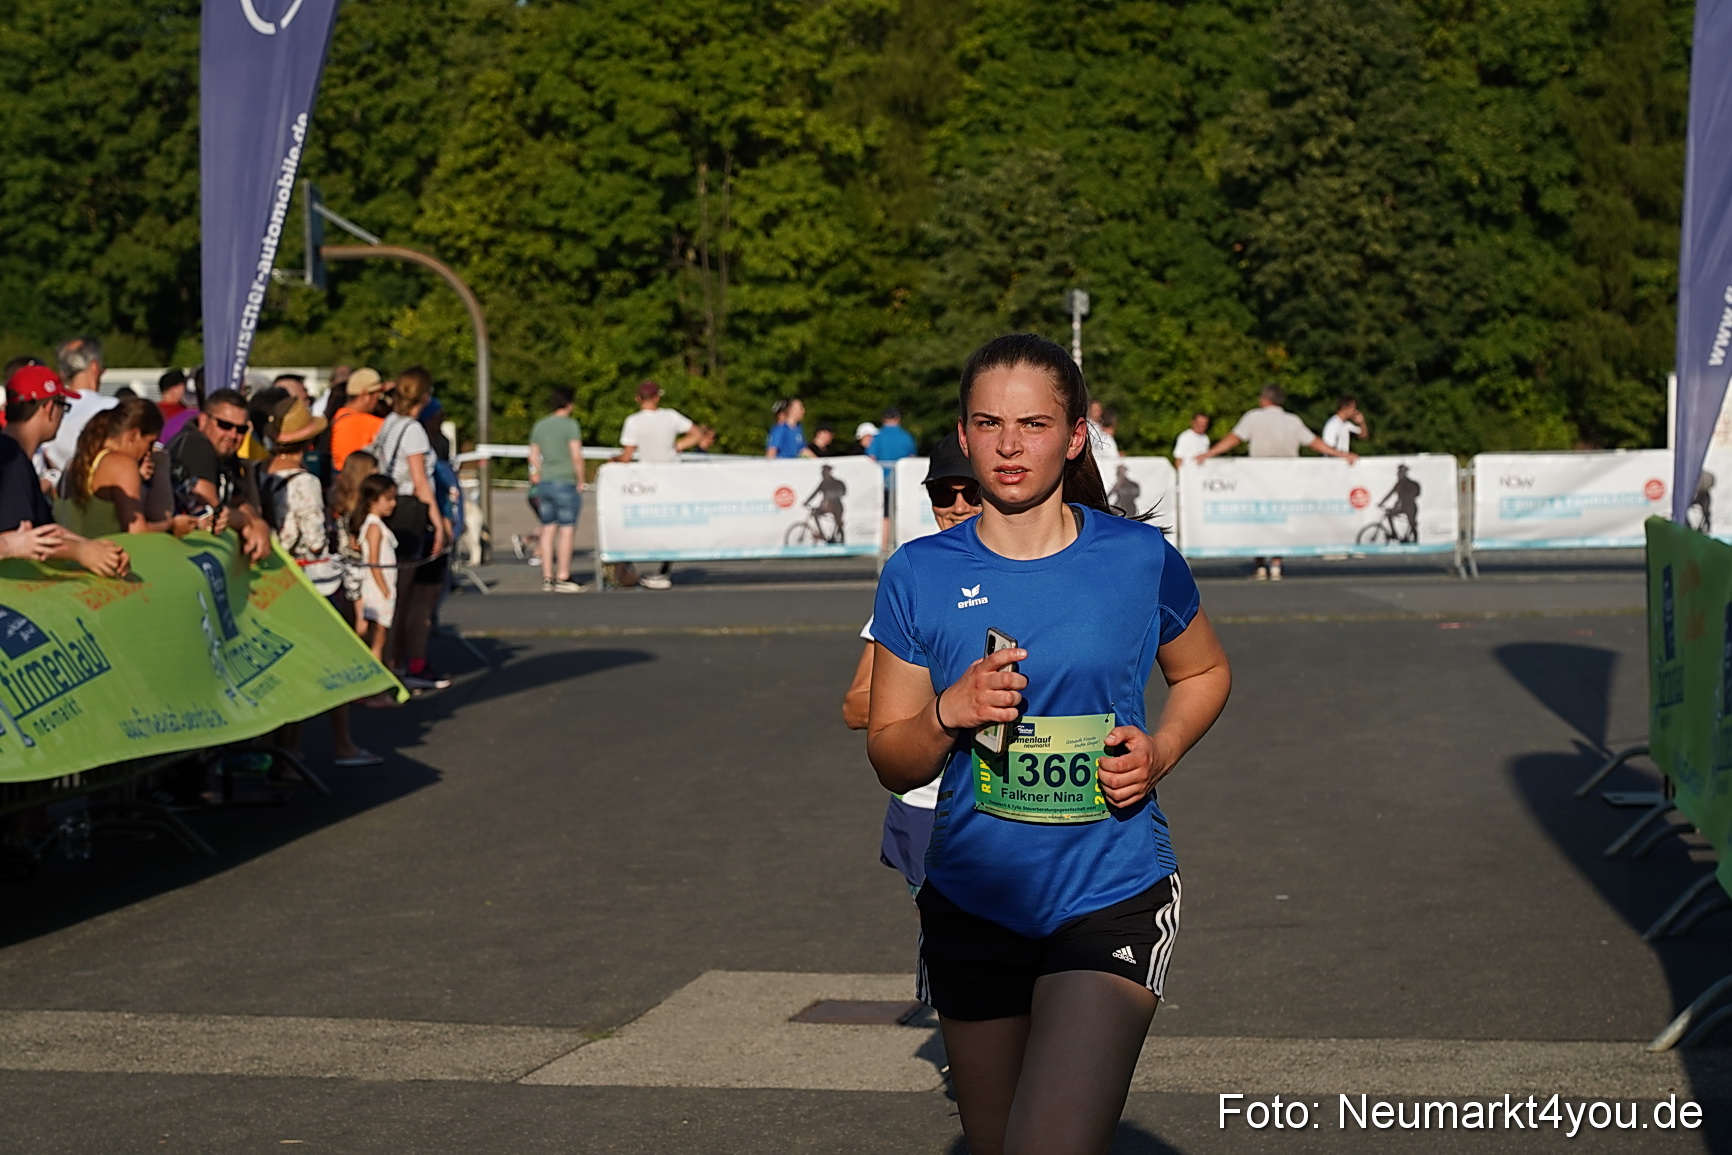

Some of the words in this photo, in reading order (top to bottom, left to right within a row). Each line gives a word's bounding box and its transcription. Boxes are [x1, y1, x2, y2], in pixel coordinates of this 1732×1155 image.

[957, 596, 989, 609] erima
[995, 752, 1092, 788] 1366
[1001, 787, 1050, 803] Falkner
[1053, 791, 1084, 803] Nina
[1022, 805, 1086, 813] Steuerberatungsgesellschaft
[1112, 951, 1137, 965] adidas
